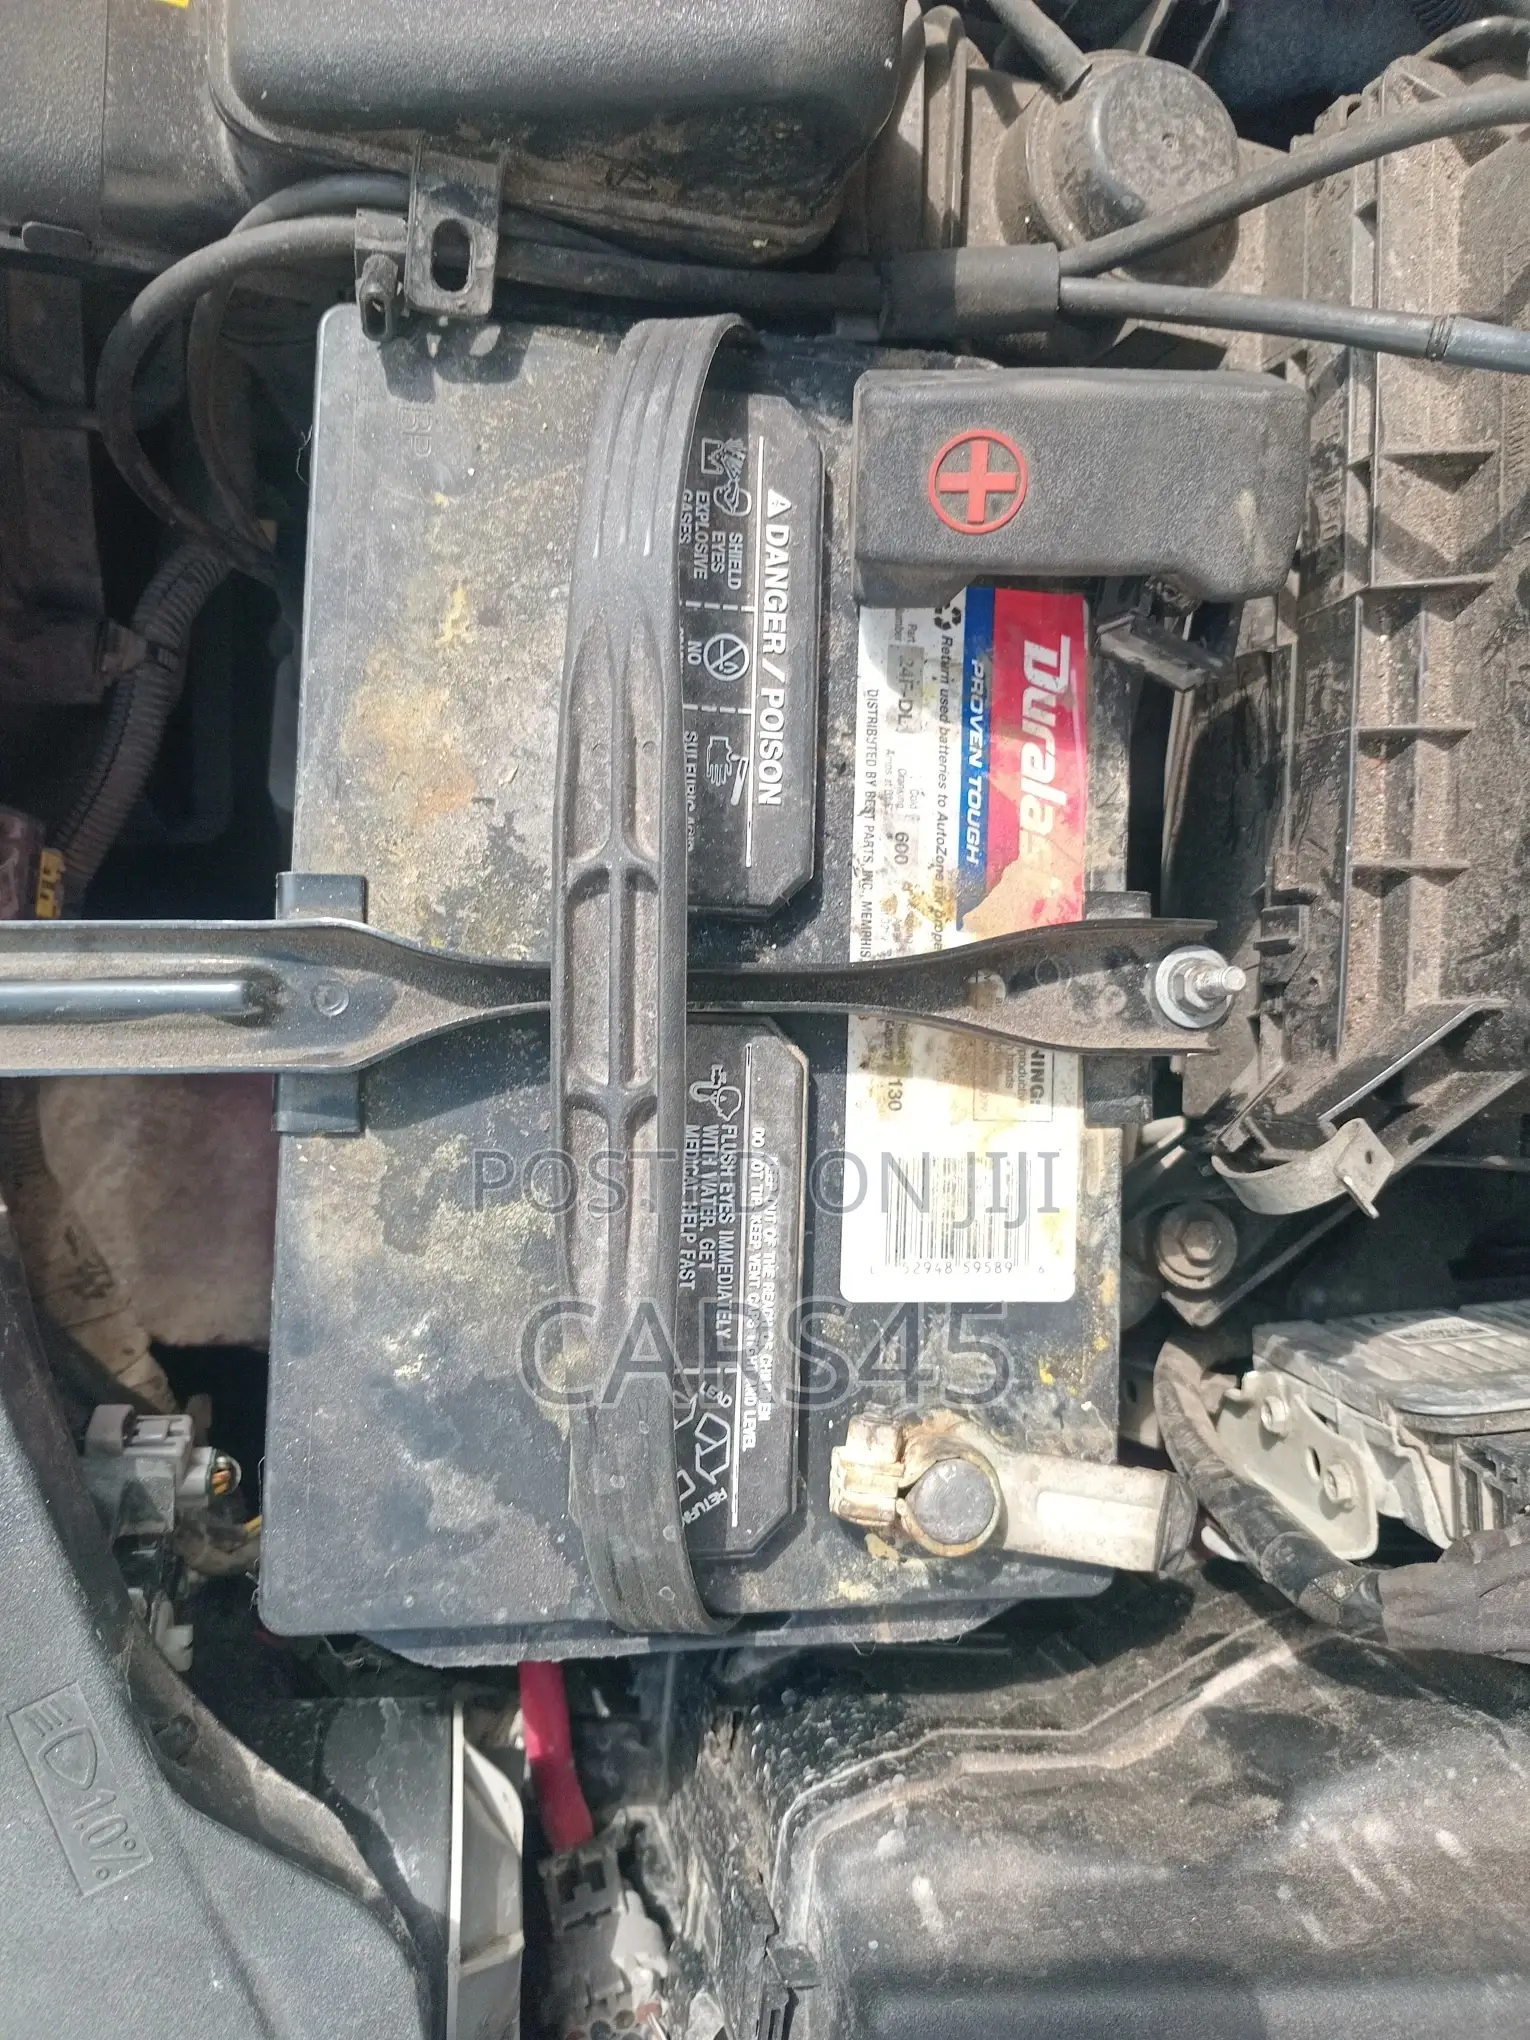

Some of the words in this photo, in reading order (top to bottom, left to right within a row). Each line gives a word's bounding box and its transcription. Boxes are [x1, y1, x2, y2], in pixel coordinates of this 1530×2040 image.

[679, 488, 693, 545] GASES
[693, 489, 710, 580] EXPLOSIVE
[711, 530, 726, 574] EYES
[727, 531, 743, 591] SHIELD
[763, 523, 790, 655] DANGER
[687, 640, 702, 665] NO
[939, 634, 953, 684] Return
[939, 689, 954, 723] used
[968, 658, 984, 768] PROVEN
[758, 687, 785, 805] POISON
[938, 726, 954, 790] batteries
[1019, 634, 1071, 868] Duralas
[864, 771, 877, 787] BY
[863, 791, 876, 820] BEST
[937, 794, 949, 807] to
[966, 775, 982, 865] TOUGH
[894, 831, 910, 866] 600
[935, 811, 949, 881] AutoZone
[931, 909, 945, 951] prope
[887, 1078, 903, 1111] 130
[701, 1124, 719, 1166] WITH
[719, 1124, 737, 1177] FLUSH
[751, 1127, 765, 1148] DO
[682, 1124, 700, 1195] MEDICAL
[680, 1202, 698, 1244] HELP
[717, 1182, 735, 1224] EYES
[748, 1214, 763, 1249] KEEP
[762, 1227, 777, 1248] OF
[679, 1249, 696, 1291] FAST
[698, 1238, 715, 1271] GET
[747, 1252, 762, 1288] VENT
[762, 1250, 778, 1279] THE
[963, 1261, 1013, 1275] 59589
[714, 1230, 734, 1339] IMMEDIATELY
[761, 1281, 776, 1327] REACH
[699, 1381, 733, 1408] LEAD
[742, 1410, 756, 1452] LEVEL
